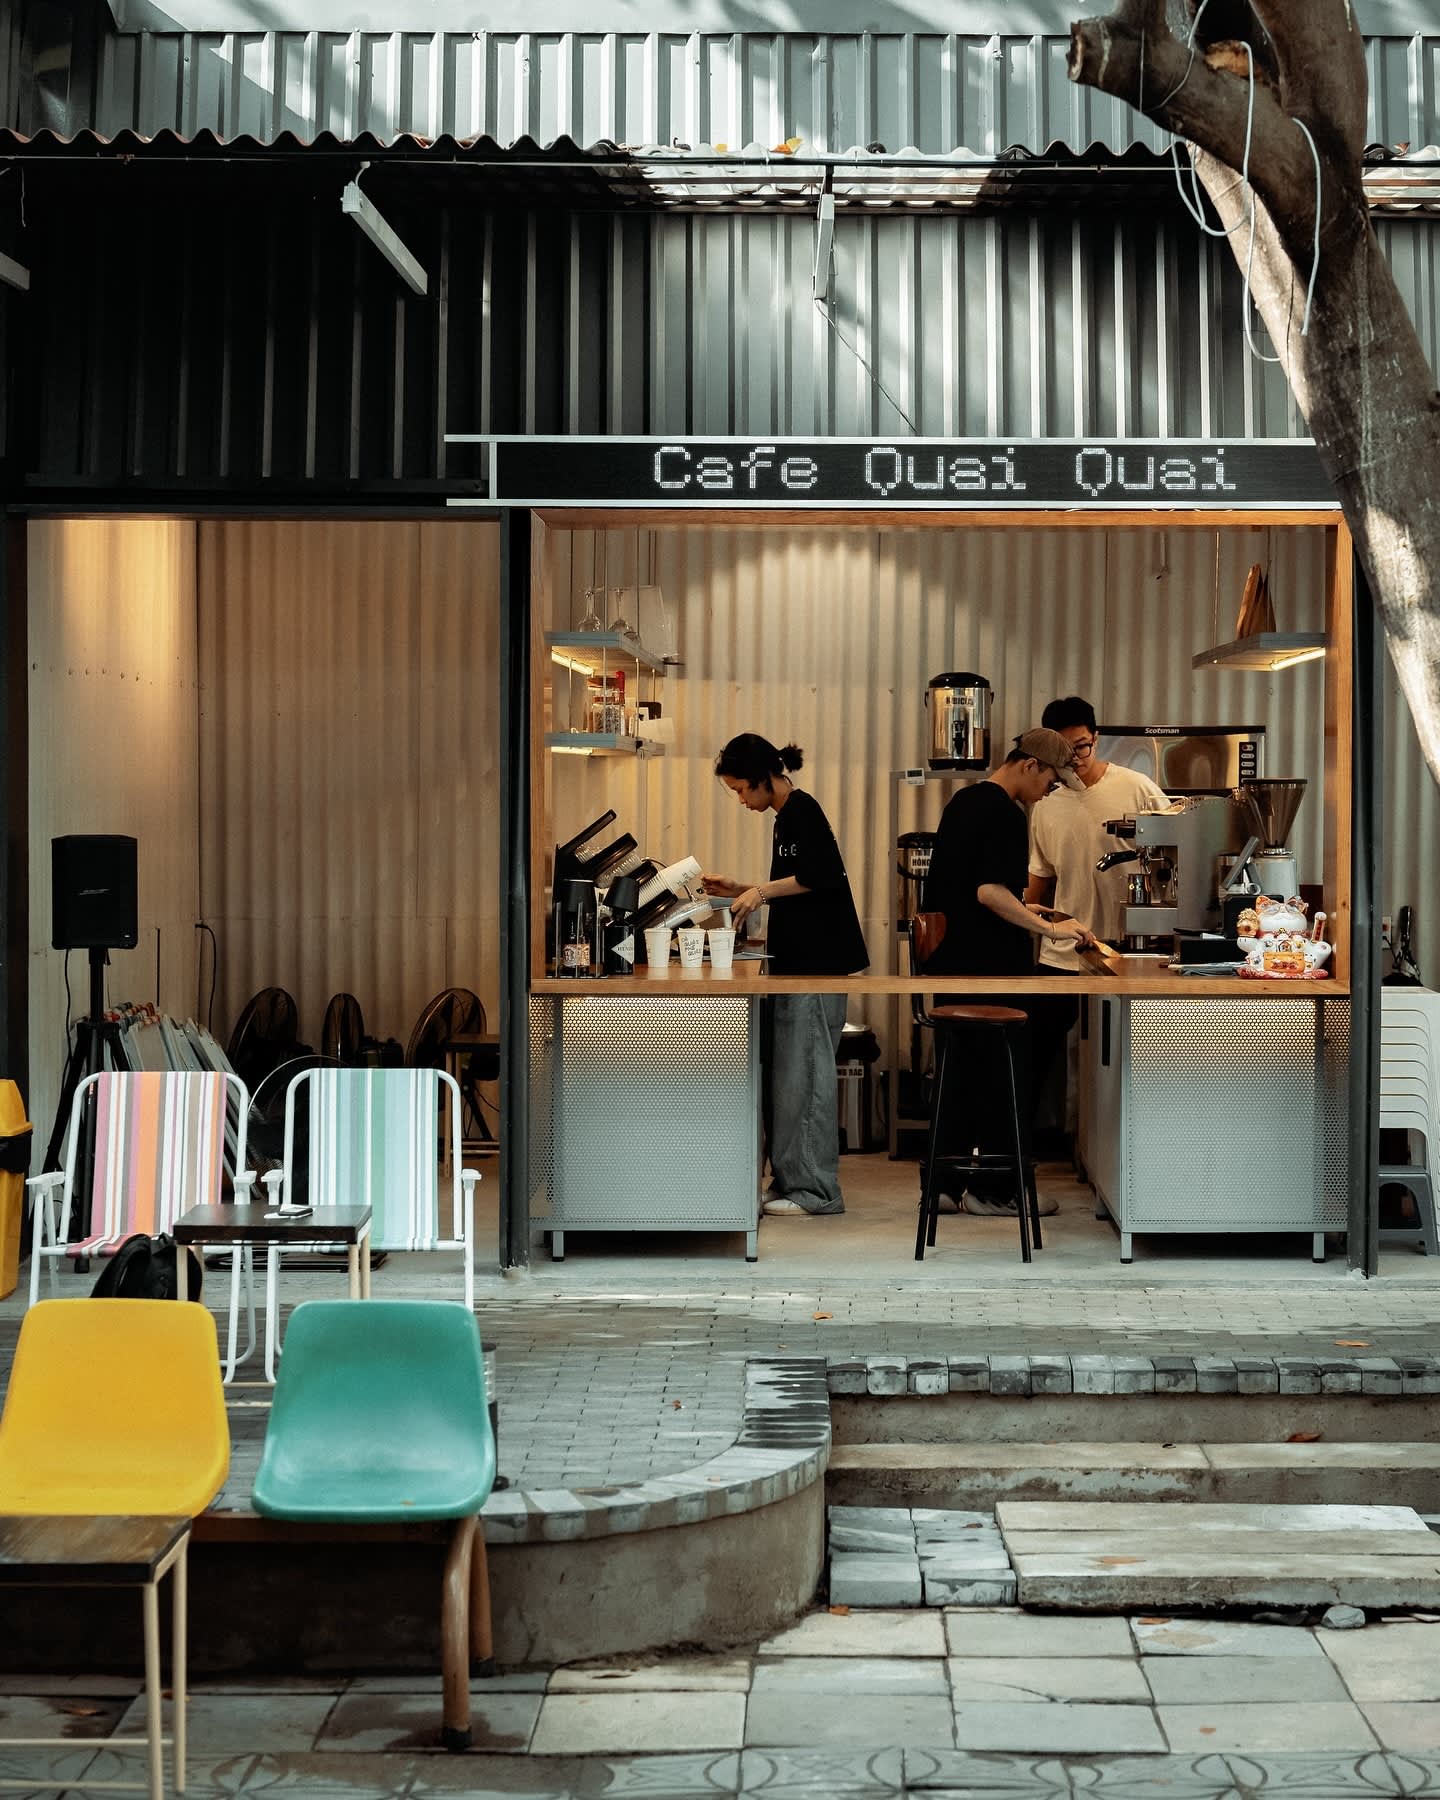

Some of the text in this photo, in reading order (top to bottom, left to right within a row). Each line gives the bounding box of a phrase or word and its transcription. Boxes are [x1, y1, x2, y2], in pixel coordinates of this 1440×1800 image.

[654, 447, 1237, 496] Cafe Quai Quai
